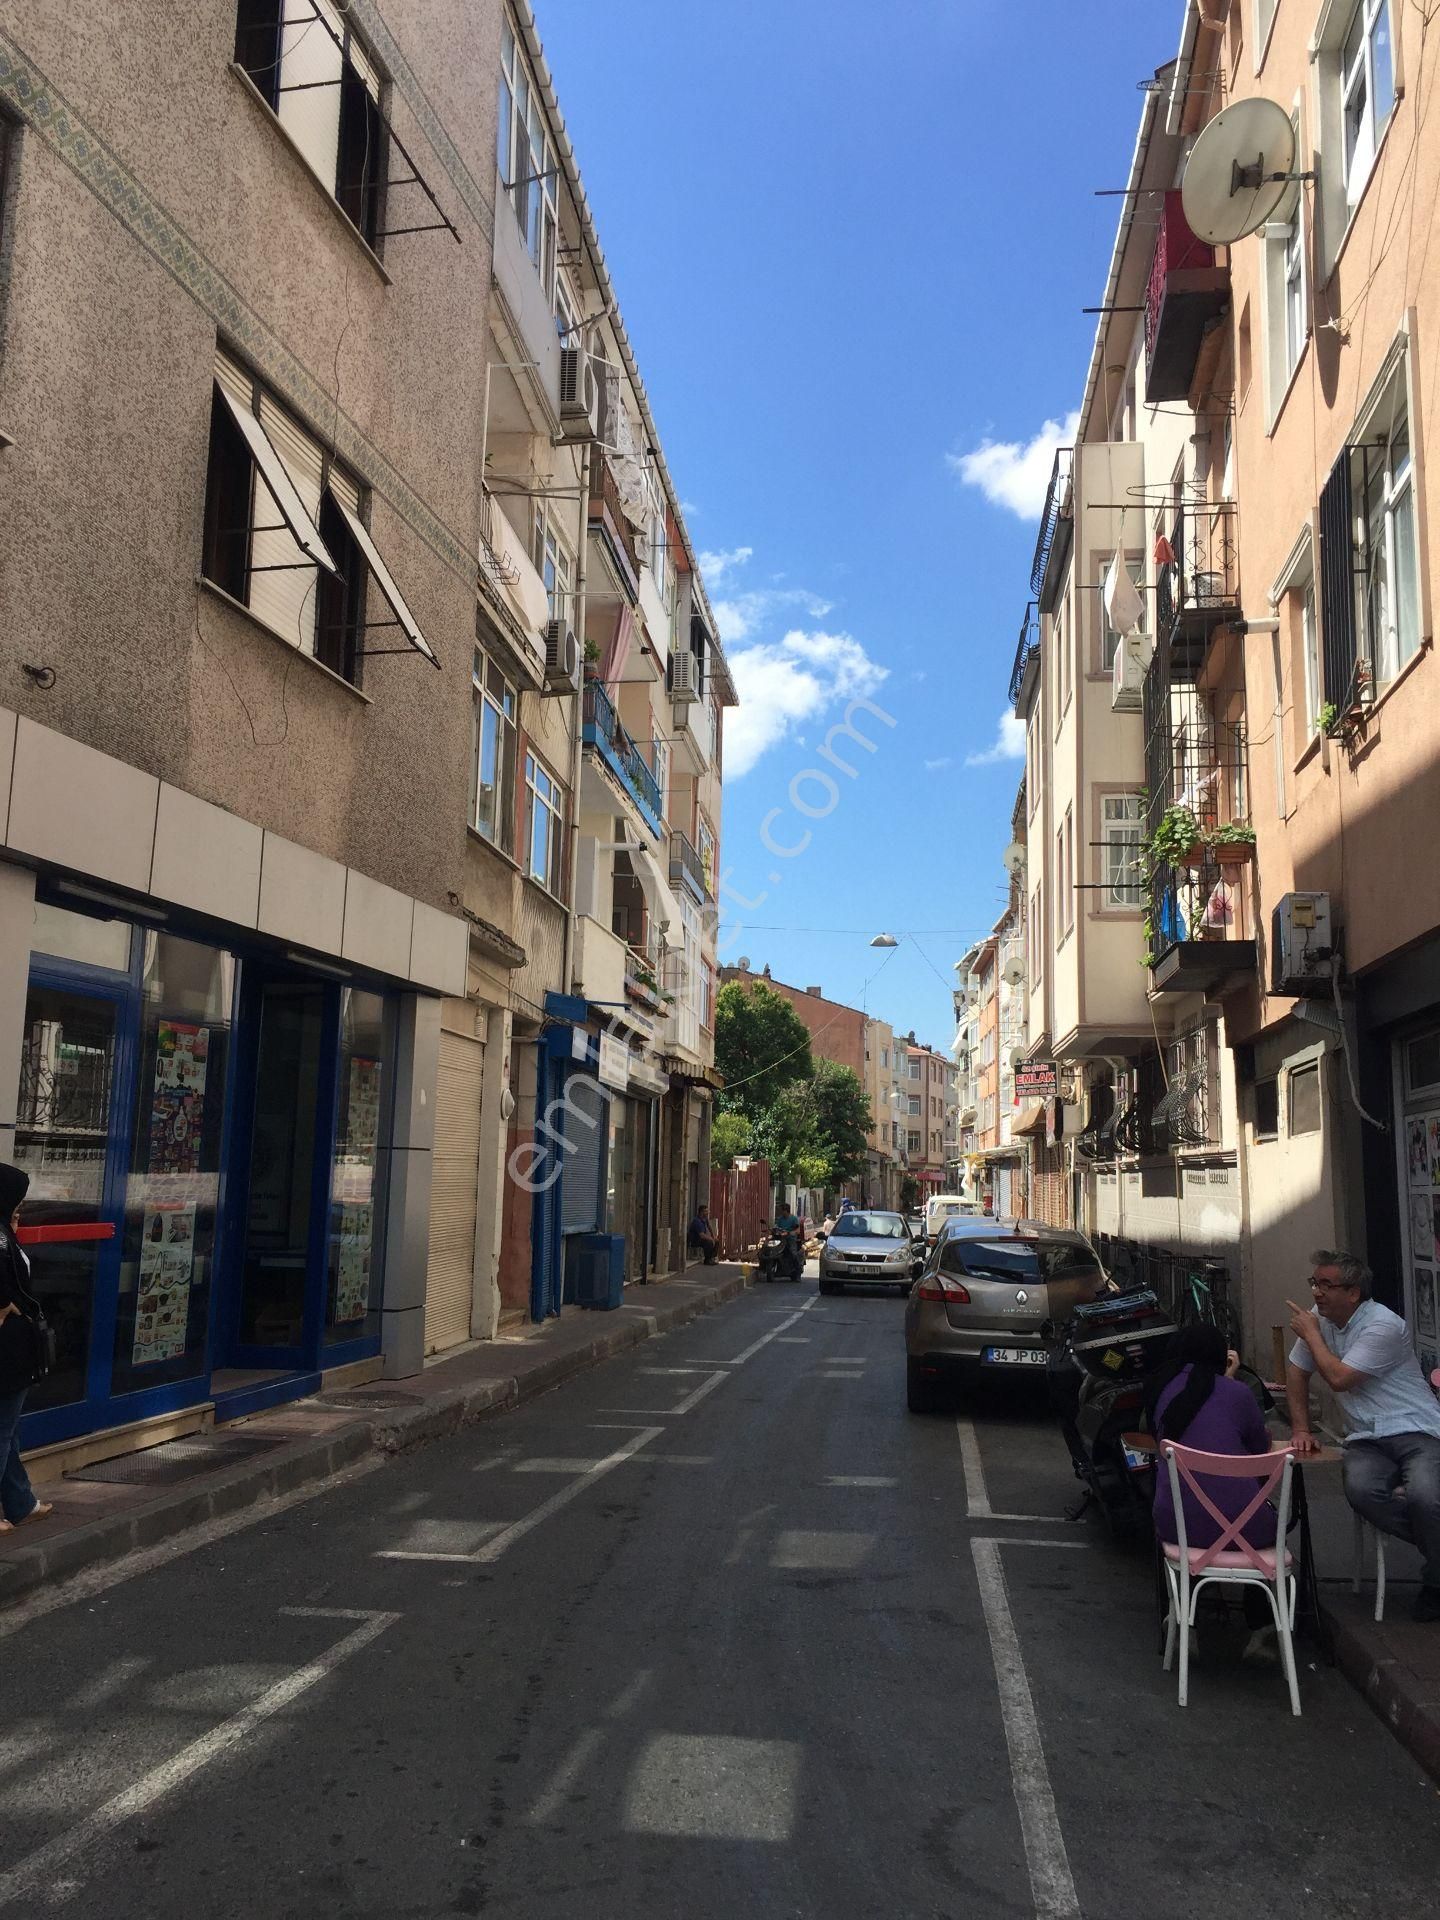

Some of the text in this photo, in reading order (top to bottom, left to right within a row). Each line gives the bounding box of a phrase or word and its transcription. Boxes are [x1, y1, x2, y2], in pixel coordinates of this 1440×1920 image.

[1016, 1072, 1056, 1085] EMLAK
[994, 1350, 1008, 1361] 34
[1013, 1350, 1028, 1362] JP
